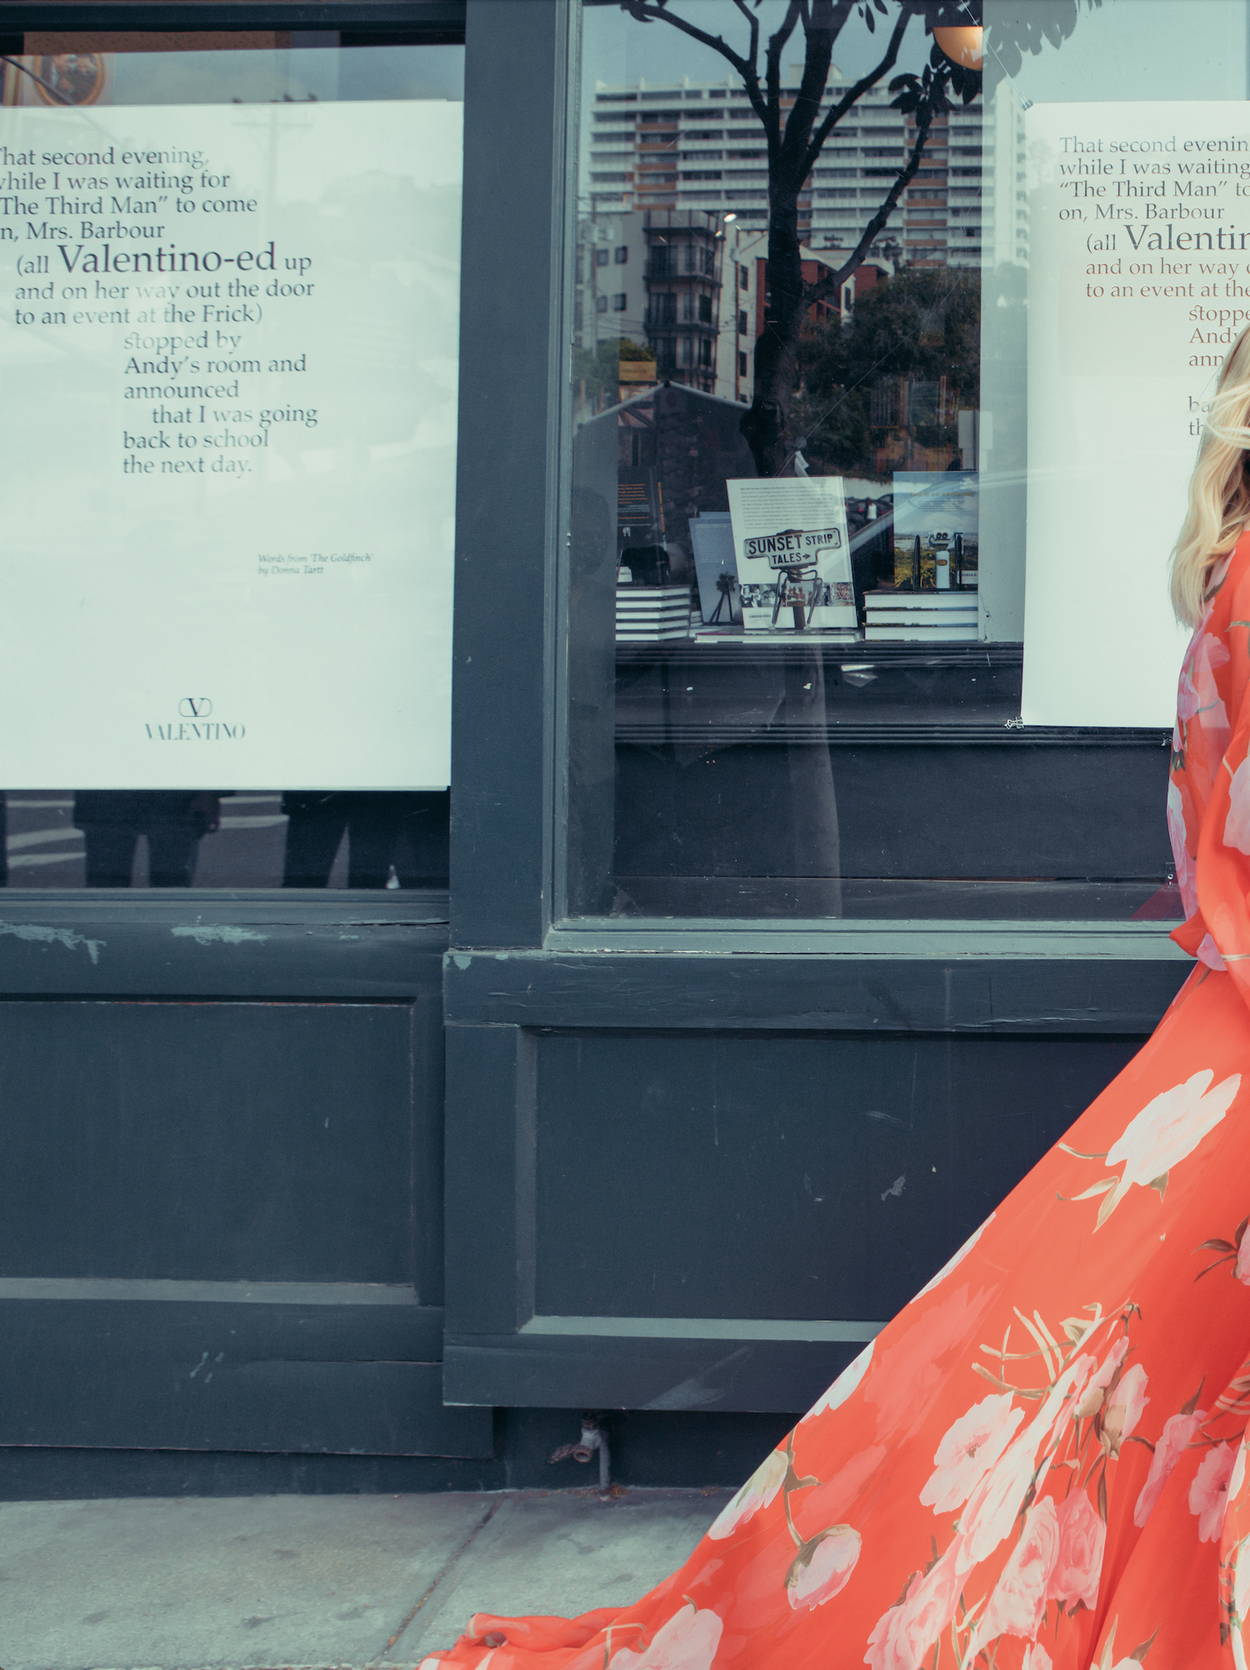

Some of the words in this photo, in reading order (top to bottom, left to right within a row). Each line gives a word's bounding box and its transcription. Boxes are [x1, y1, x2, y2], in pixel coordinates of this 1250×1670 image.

[1060, 136, 1103, 153] That
[1110, 136, 1177, 153] second
[0, 146, 36, 165] hat
[42, 147, 115, 166] second
[121, 146, 209, 170] evening,
[53, 172, 61, 190] I
[67, 177, 109, 190] was
[115, 171, 194, 195] waiting
[200, 169, 231, 189] for
[1060, 180, 1106, 197] "The
[1112, 180, 1166, 197] Third
[1173, 180, 1228, 197] Man"
[45, 195, 104, 215] Third
[110, 195, 169, 215] Man"
[176, 199, 196, 214] to
[202, 201, 258, 214] come
[1059, 208, 1088, 222] on,
[1095, 203, 1138, 220] Mrs.
[1145, 203, 1225, 219] Barbour
[0, 226, 19, 242] n,
[26, 222, 73, 240] Mrs.
[80, 221, 165, 240] Barbour
[1086, 233, 1117, 254] (all
[16, 254, 49, 277] (all
[56, 241, 277, 274] Valentino-ed
[285, 257, 312, 276] up
[1086, 283, 1104, 298] to
[1111, 285, 1133, 298] an
[1140, 283, 1195, 298] event
[1201, 283, 1218, 297] at
[124, 332, 209, 356] stopped
[216, 330, 242, 355] by
[124, 355, 201, 380] Andy's
[207, 359, 262, 373] room
[268, 354, 306, 372] and
[124, 380, 239, 399] announced
[152, 404, 193, 424] that
[199, 405, 206, 423] I
[213, 410, 254, 423] was
[259, 405, 319, 428] going
[123, 430, 171, 449] back
[178, 433, 198, 449] to
[203, 429, 269, 448] school
[123, 454, 155, 474] the
[161, 457, 206, 474] next
[211, 455, 253, 478] day.
[748, 534, 802, 554] SUNSET
[805, 534, 833, 546] STRIP
[258, 554, 285, 563] Words
[287, 554, 307, 565] from
[772, 552, 802, 564] TALES
[258, 565, 268, 575] by
[270, 565, 300, 574] Donna
[303, 565, 324, 574] Tartt
[145, 723, 245, 740] VALENTINO
